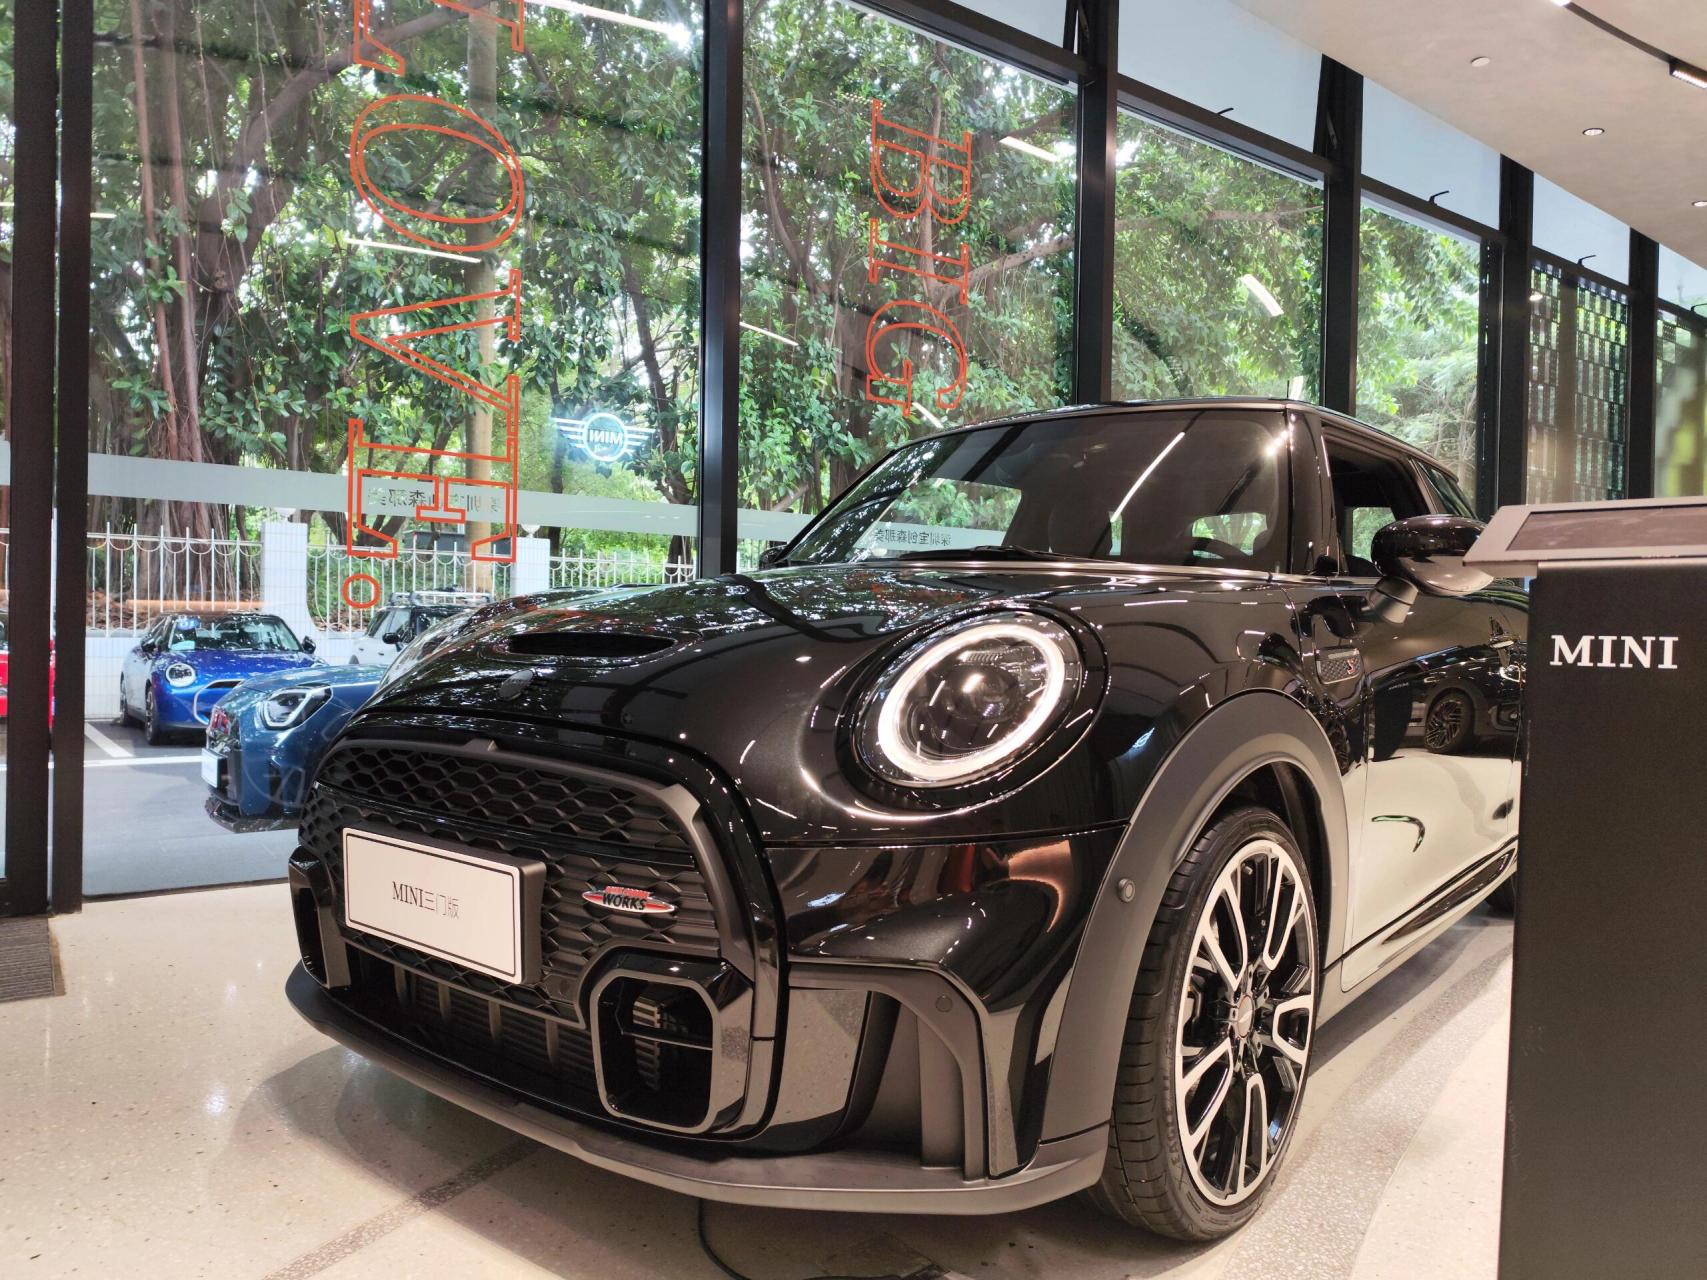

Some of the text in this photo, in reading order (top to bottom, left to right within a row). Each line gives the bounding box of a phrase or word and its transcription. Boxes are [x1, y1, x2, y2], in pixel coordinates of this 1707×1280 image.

[865, 99, 972, 417] BIG
[1549, 634, 1679, 669] MINI
[602, 893, 647, 911] WORKS
